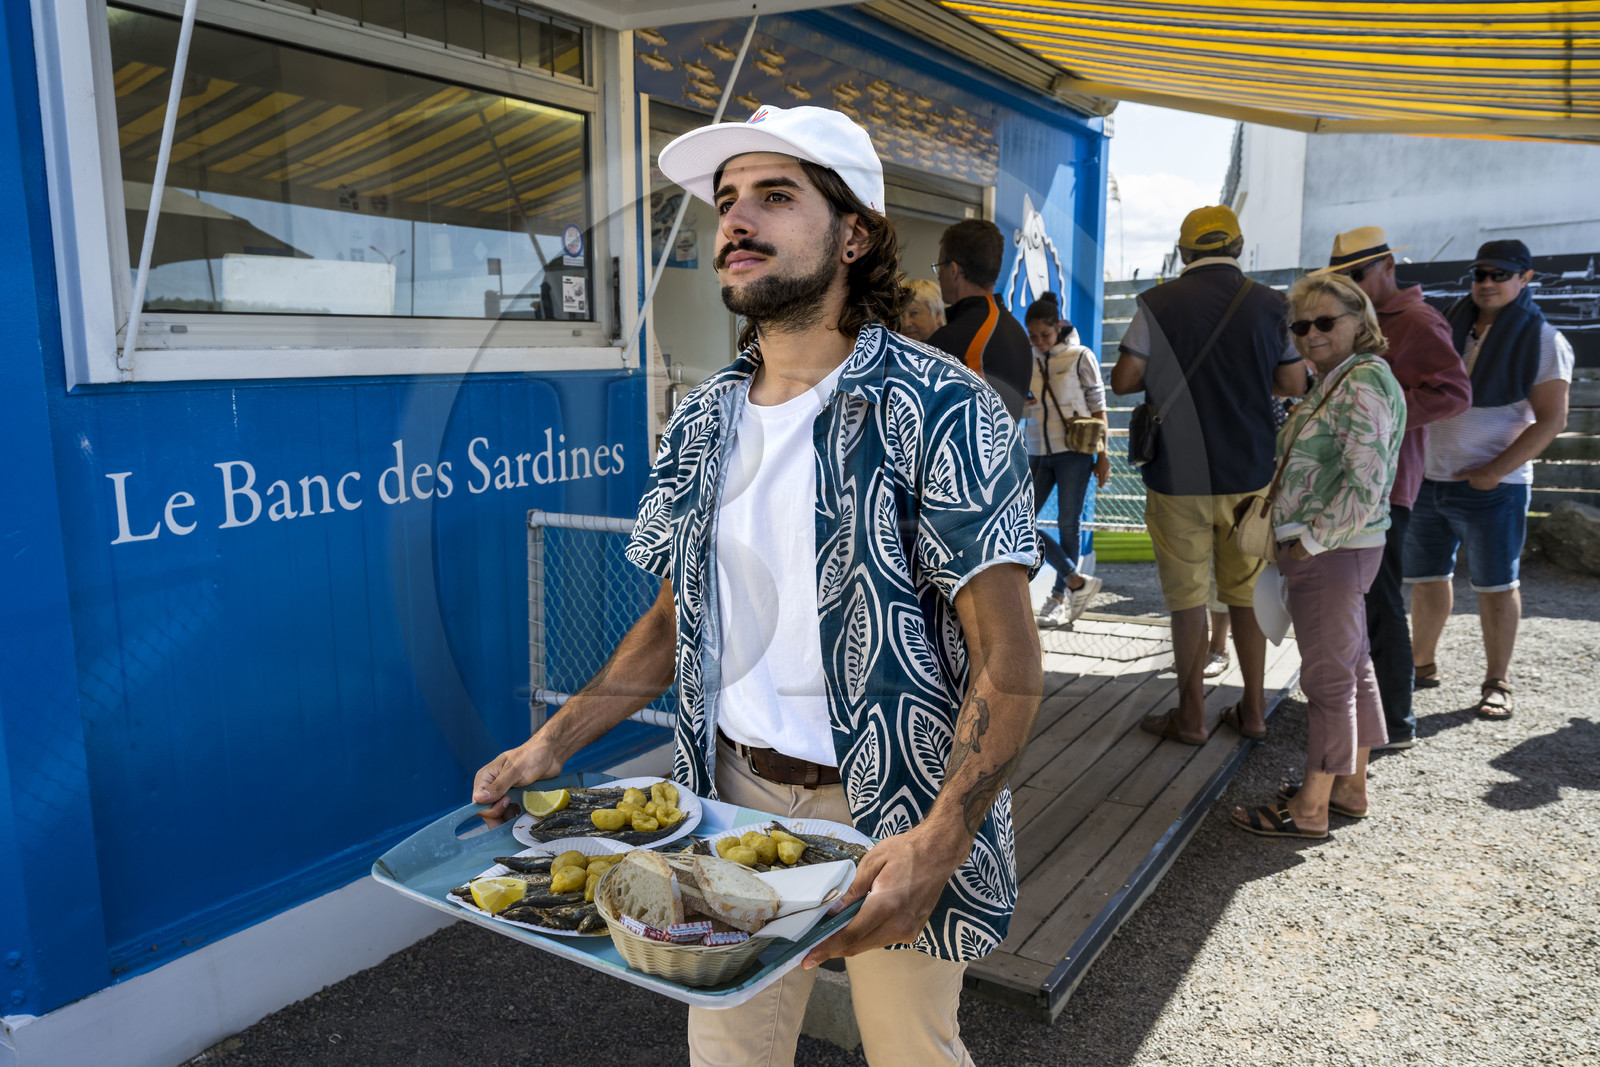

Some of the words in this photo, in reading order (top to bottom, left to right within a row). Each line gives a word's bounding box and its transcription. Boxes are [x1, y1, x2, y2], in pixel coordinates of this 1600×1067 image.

[105, 471, 197, 545] Le
[213, 460, 363, 529] Banc
[378, 439, 454, 505] des
[467, 427, 625, 494] Sardines
